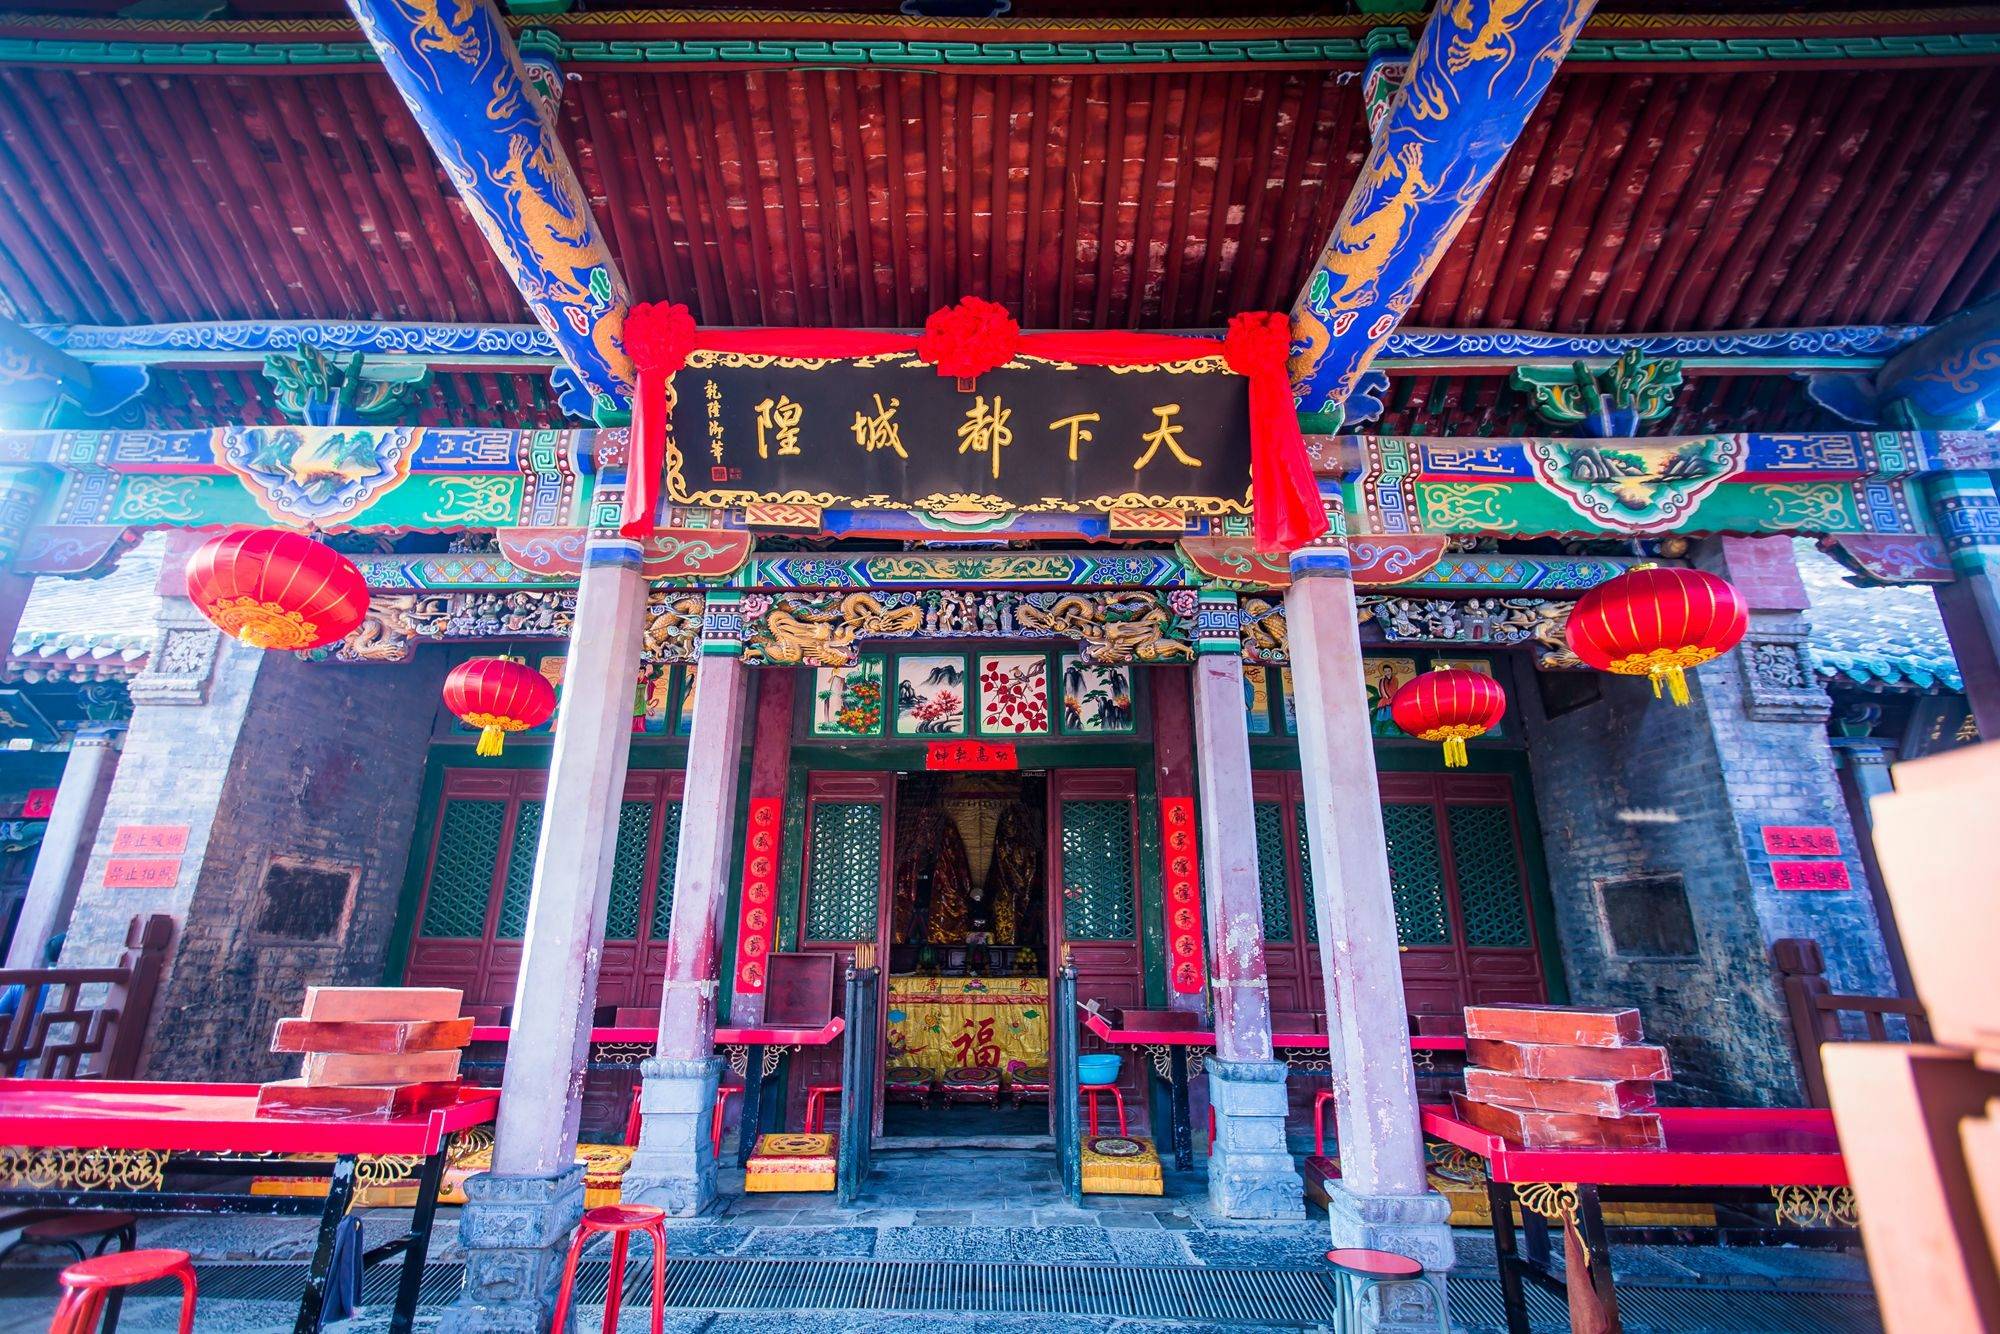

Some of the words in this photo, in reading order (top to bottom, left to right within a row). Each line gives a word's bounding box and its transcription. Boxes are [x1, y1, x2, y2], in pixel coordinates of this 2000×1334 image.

[753, 393, 1203, 479] 天下都城隍
[951, 1016, 1001, 1068] 福
